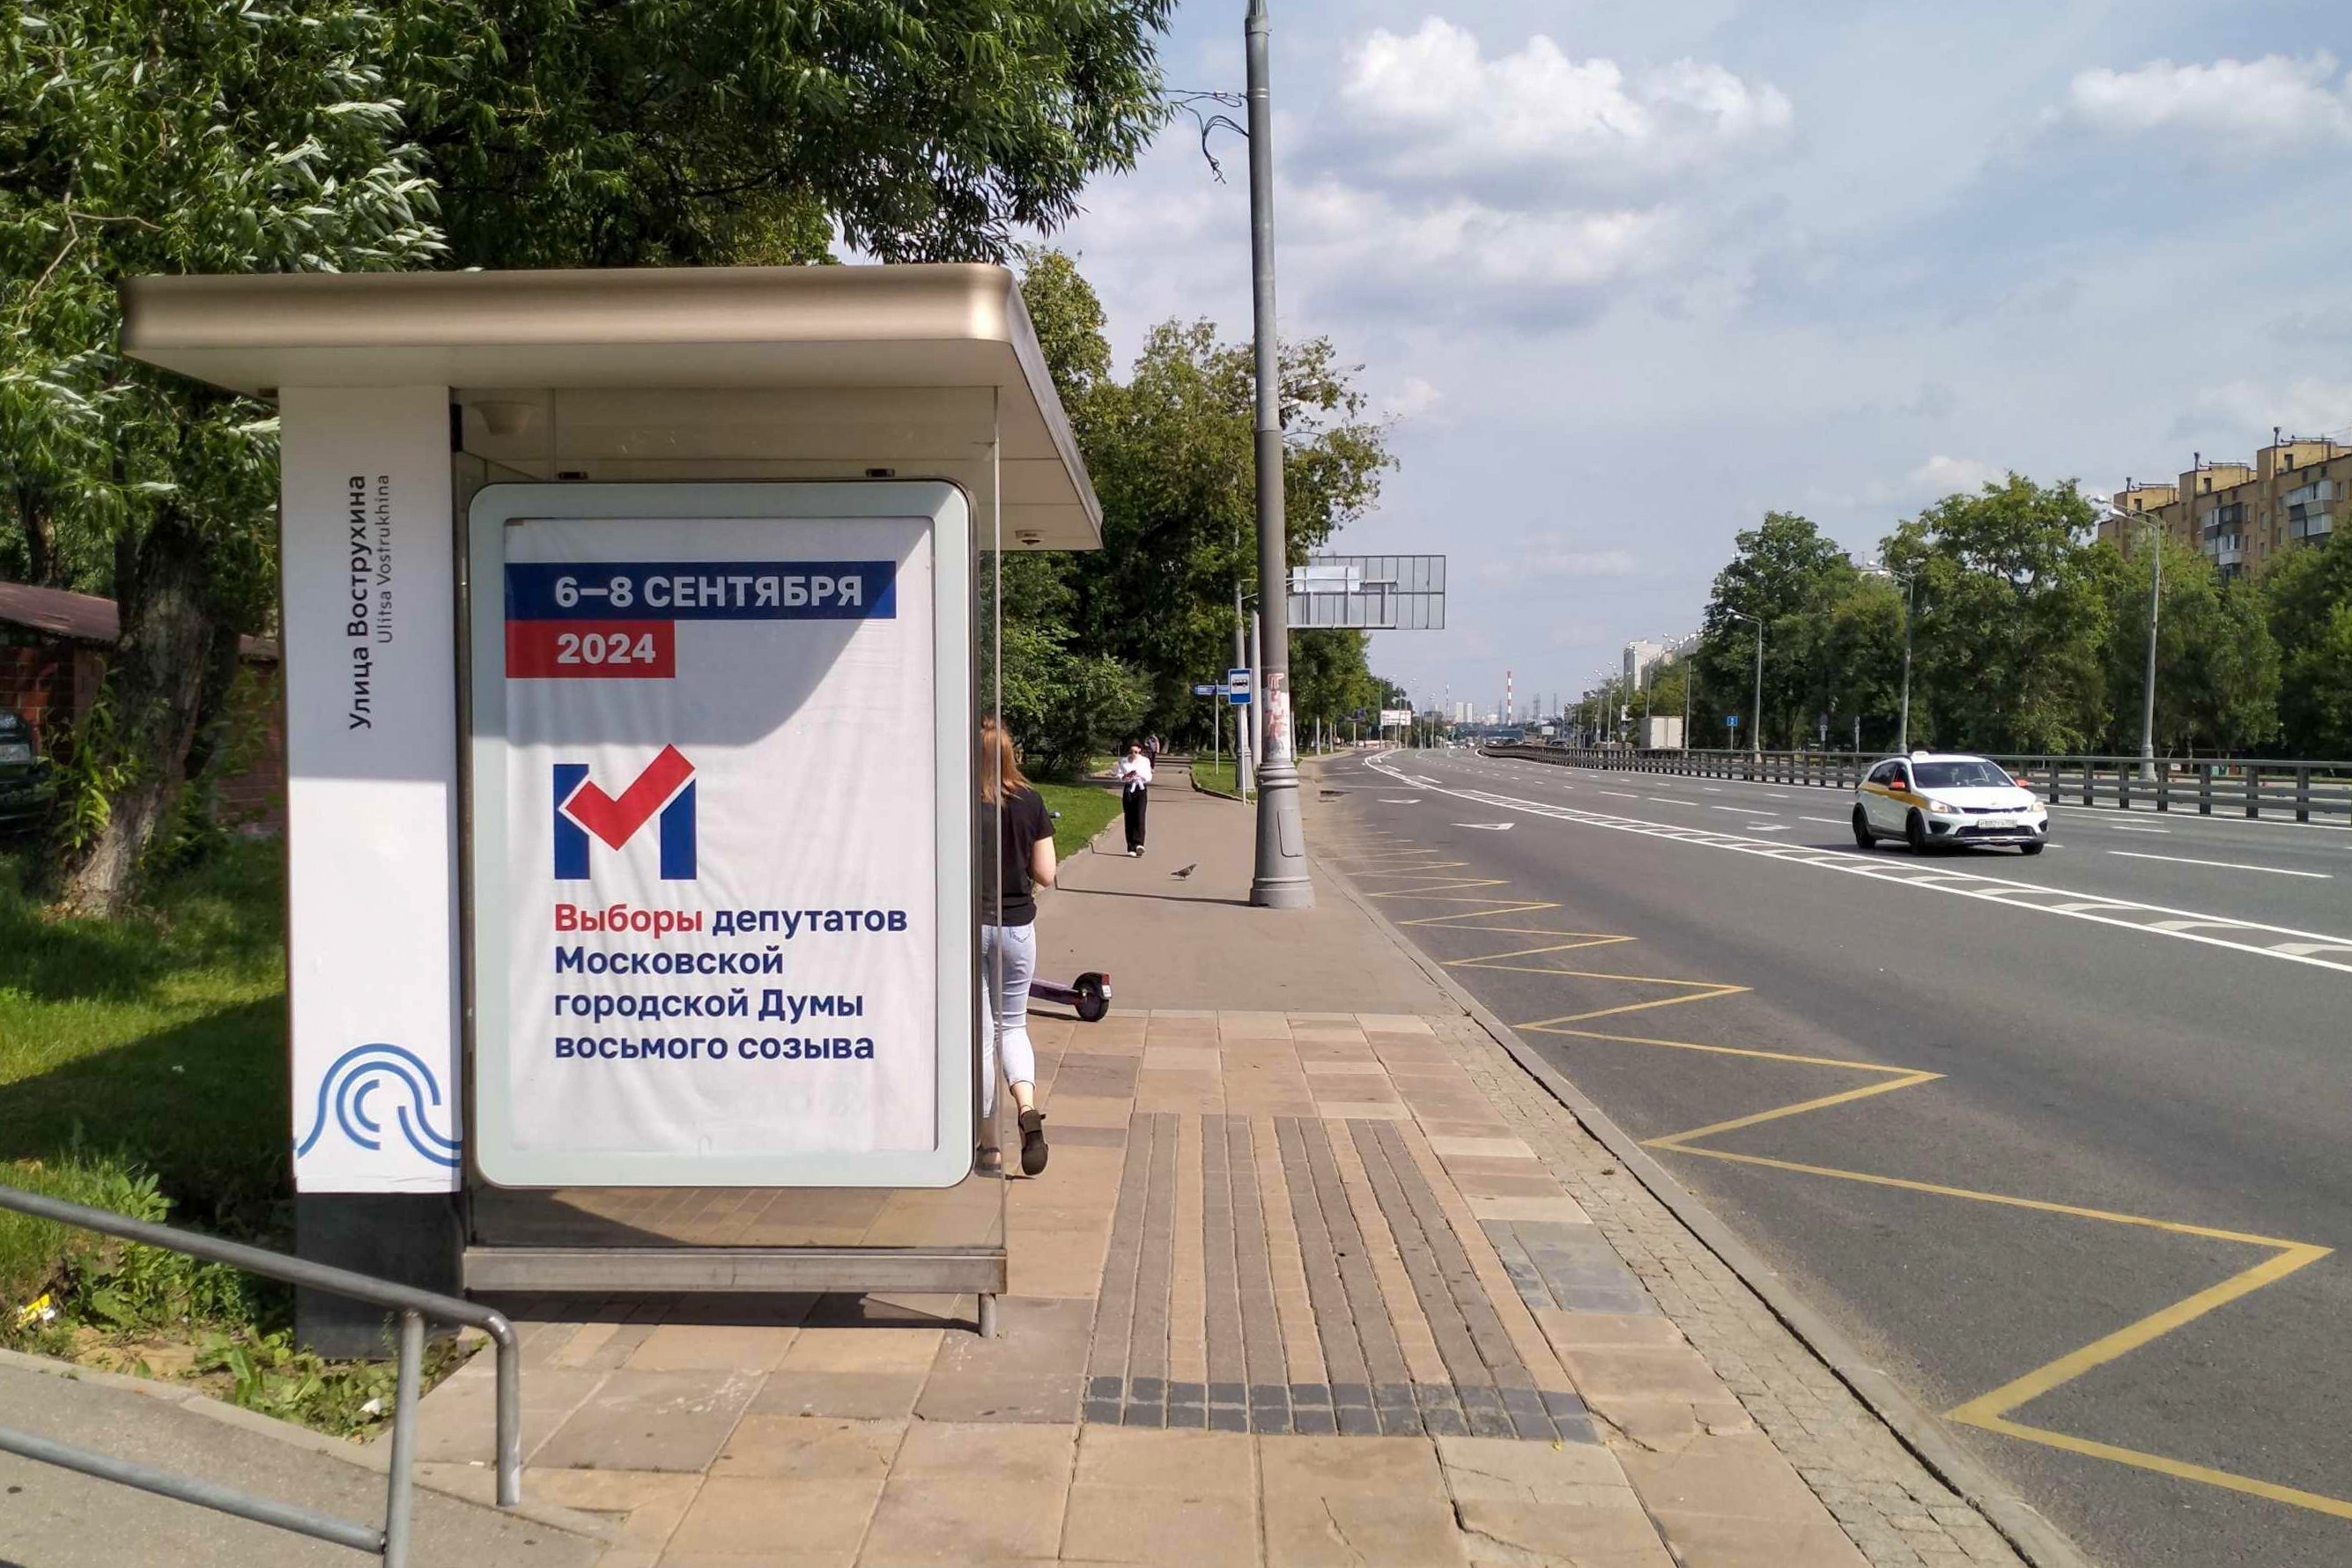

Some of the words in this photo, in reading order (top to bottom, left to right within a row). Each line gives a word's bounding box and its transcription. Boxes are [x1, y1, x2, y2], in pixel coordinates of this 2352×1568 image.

[374, 474, 393, 587] Vostrukhina
[347, 475, 374, 637] Вострухина
[645, 576, 862, 607] СЕНТЯБРЯ
[376, 590, 394, 644] Ulitsa
[557, 633, 656, 664] 2024
[348, 646, 374, 730] Улица
[555, 903, 703, 939] Выборы
[712, 909, 907, 939] депутатов
[555, 944, 783, 975] Московской
[555, 987, 749, 1024] городской
[758, 988, 863, 1024] Думы
[555, 1037, 729, 1061] восьмого
[737, 1037, 874, 1061] созыва
